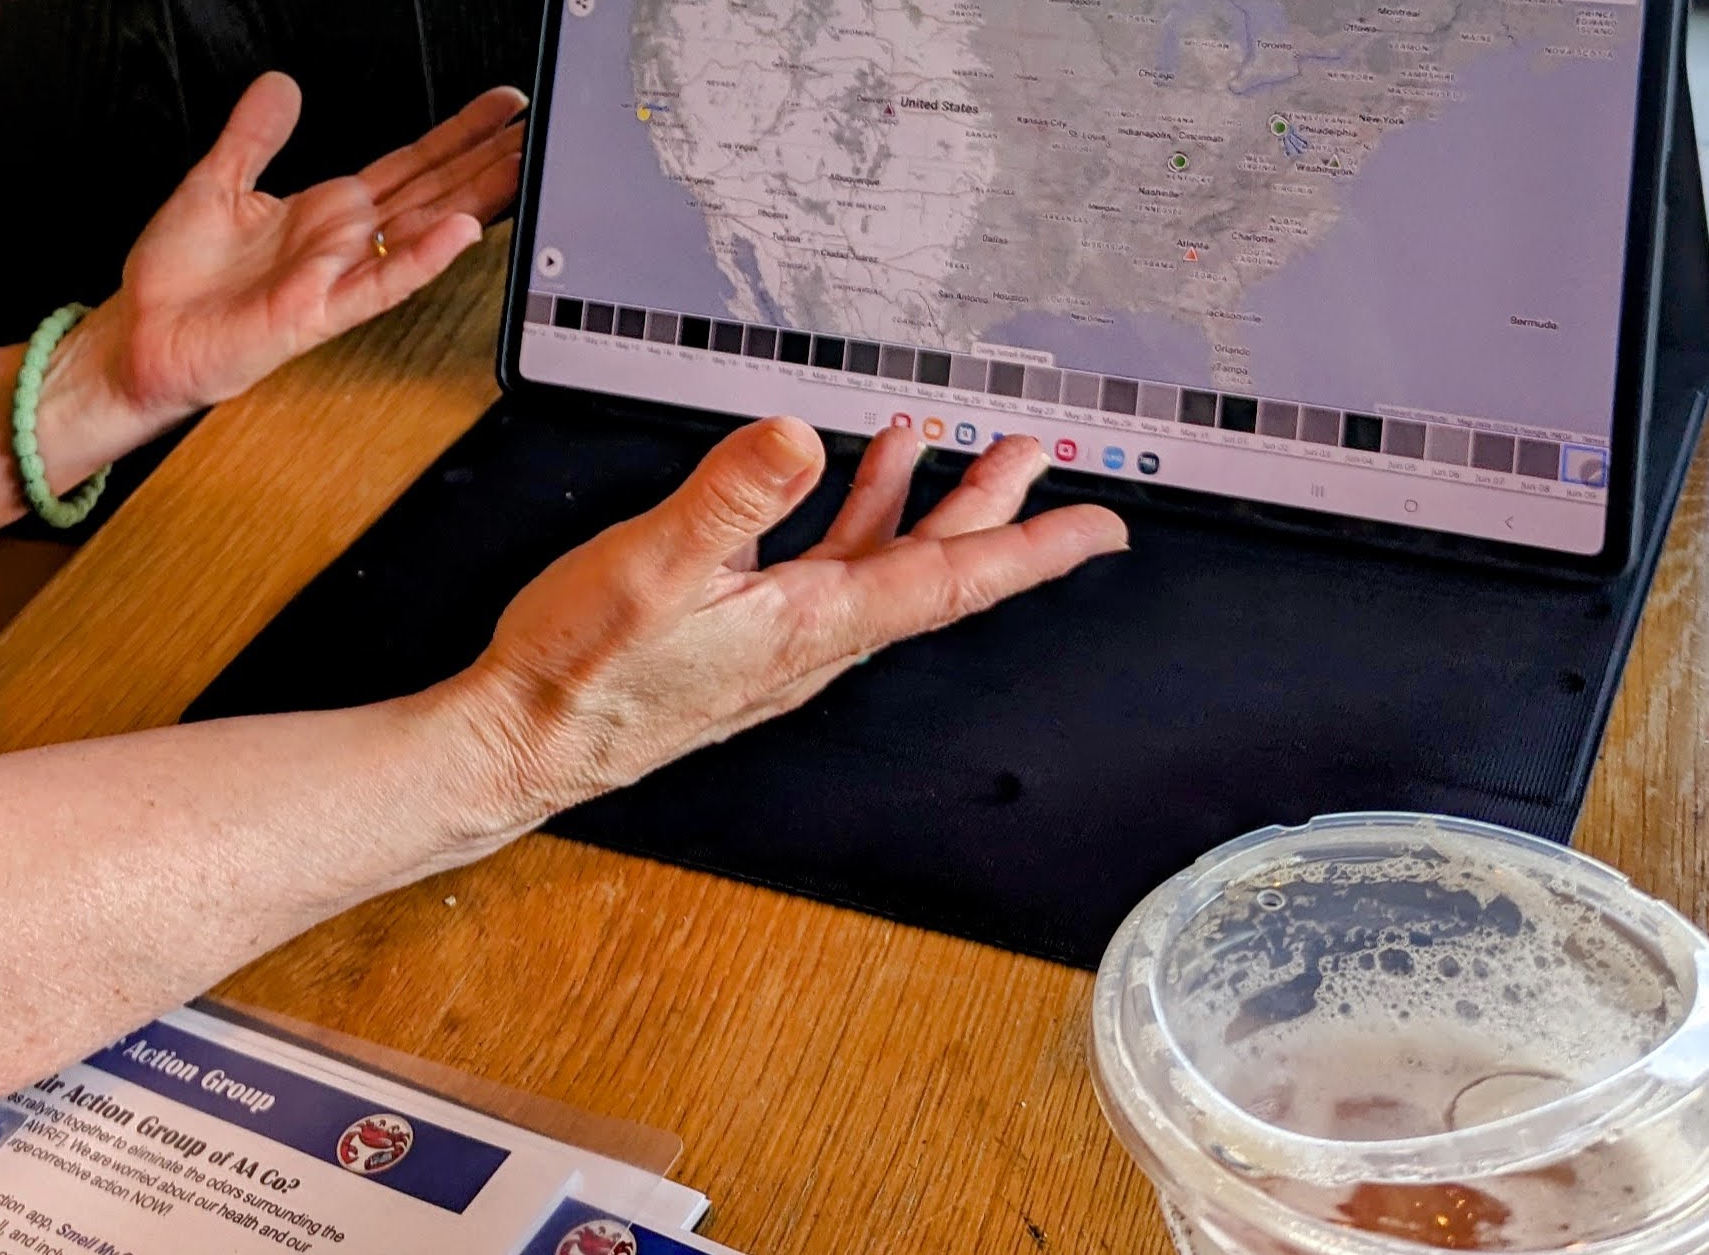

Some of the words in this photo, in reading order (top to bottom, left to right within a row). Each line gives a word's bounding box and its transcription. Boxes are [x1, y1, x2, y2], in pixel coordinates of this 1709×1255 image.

[900, 96, 938, 112] United
[941, 100, 979, 115] States
[1510, 315, 1558, 330] Bermuda
[122, 1039, 201, 1082] Action
[201, 1068, 276, 1115] Group
[21, 1097, 66, 1124] rallying
[62, 1112, 116, 1144] together
[112, 1136, 128, 1150] to
[127, 1144, 184, 1174] eliminate
[184, 1165, 206, 1183] the
[206, 1176, 244, 1200] odors
[242, 1193, 322, 1236] surrounding
[320, 1224, 346, 1243] the
[61, 1084, 136, 1127] Action
[136, 1115, 208, 1159] Group
[208, 1151, 235, 1167] of
[228, 1157, 259, 1180] AA
[259, 1169, 301, 1194] Co?
[31, 1146, 92, 1180] corrective
[90, 1172, 130, 1199] action
[129, 1191, 174, 1217] NOW!
[69, 1137, 92, 1158] We
[89, 1150, 113, 1166] are
[111, 1159, 161, 1187] worried
[156, 1179, 196, 1204] about
[194, 1197, 220, 1213] our
[216, 1202, 260, 1231] health
[258, 1222, 291, 1244] and
[286, 1235, 313, 1254] our
[8, 1228, 40, 1250] and
[25, 1209, 53, 1232] app,
[55, 1223, 100, 1250] Smell
